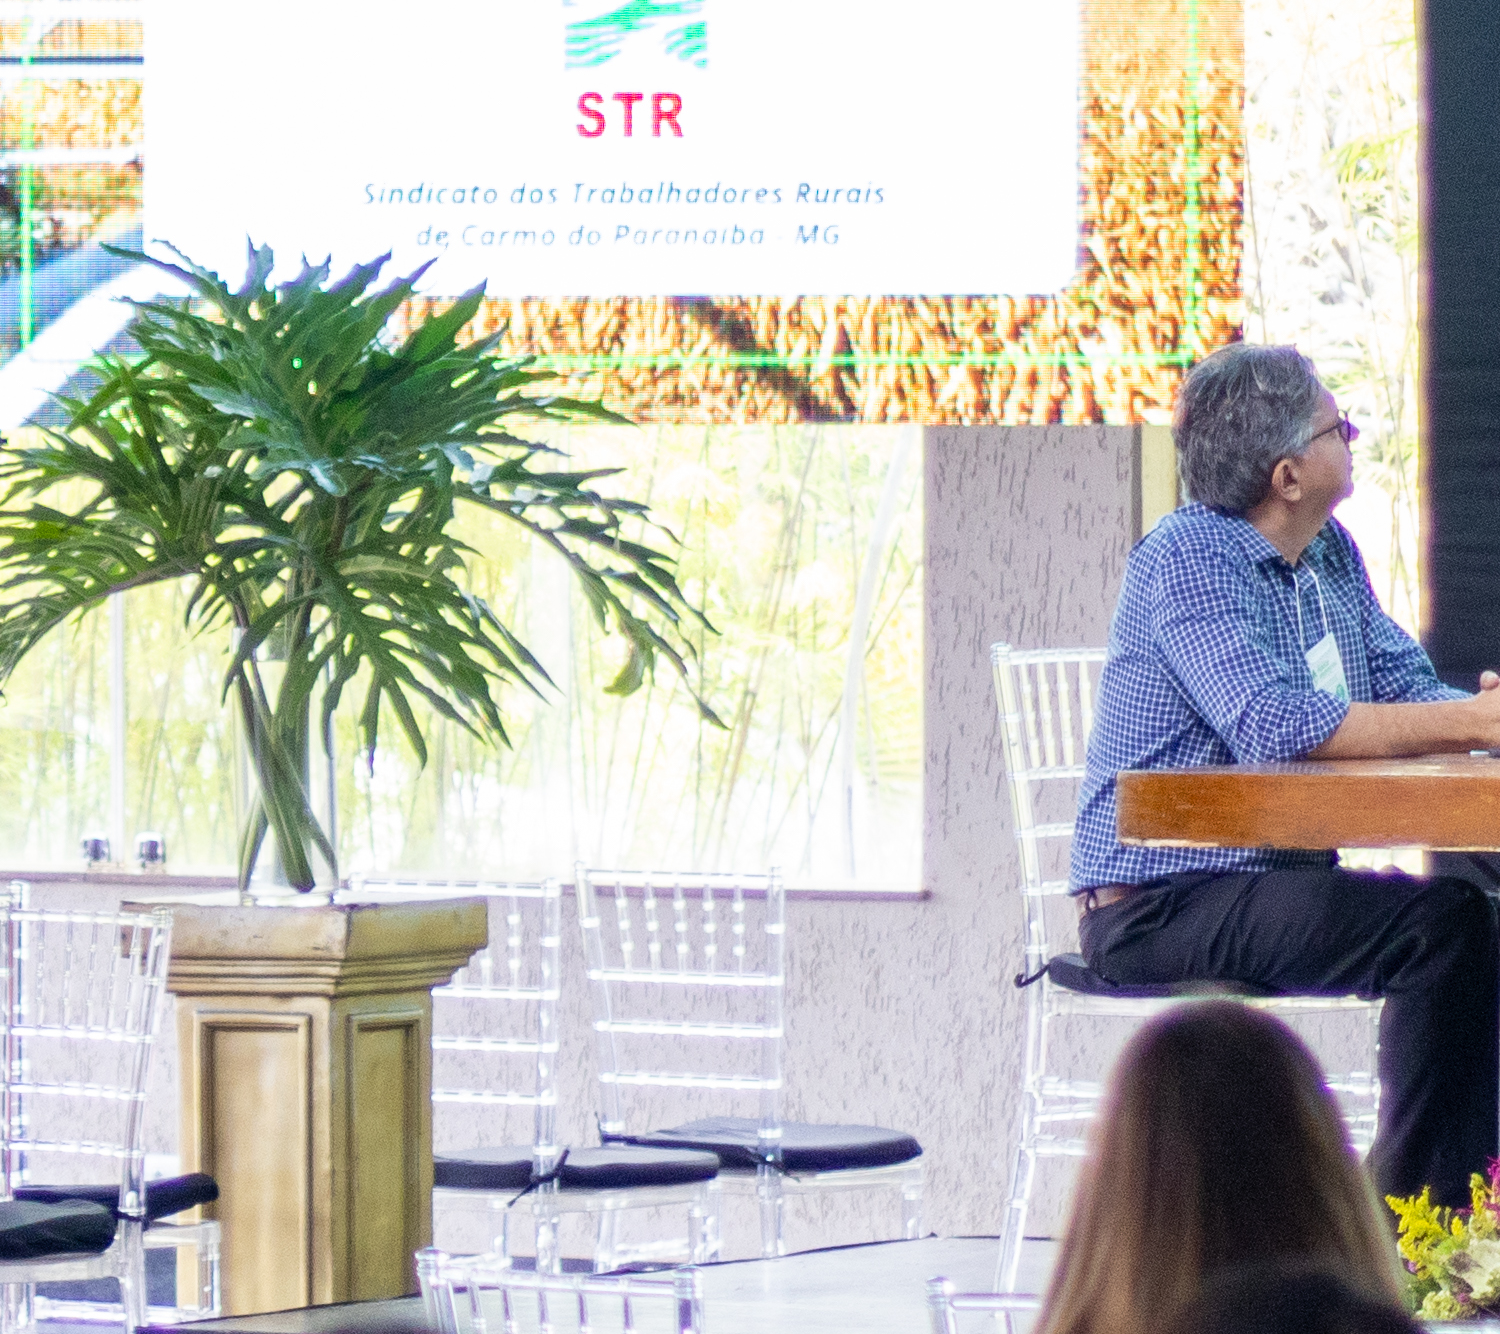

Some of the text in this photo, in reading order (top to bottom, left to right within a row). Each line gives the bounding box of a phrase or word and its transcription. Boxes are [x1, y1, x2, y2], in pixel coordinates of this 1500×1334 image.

[577, 92, 683, 138] STR
[365, 182, 883, 204] Sindicato dos Trabalhadores Rurais
[462, 225, 555, 246] Carmo
[569, 225, 601, 245] do
[798, 225, 839, 244] MG
